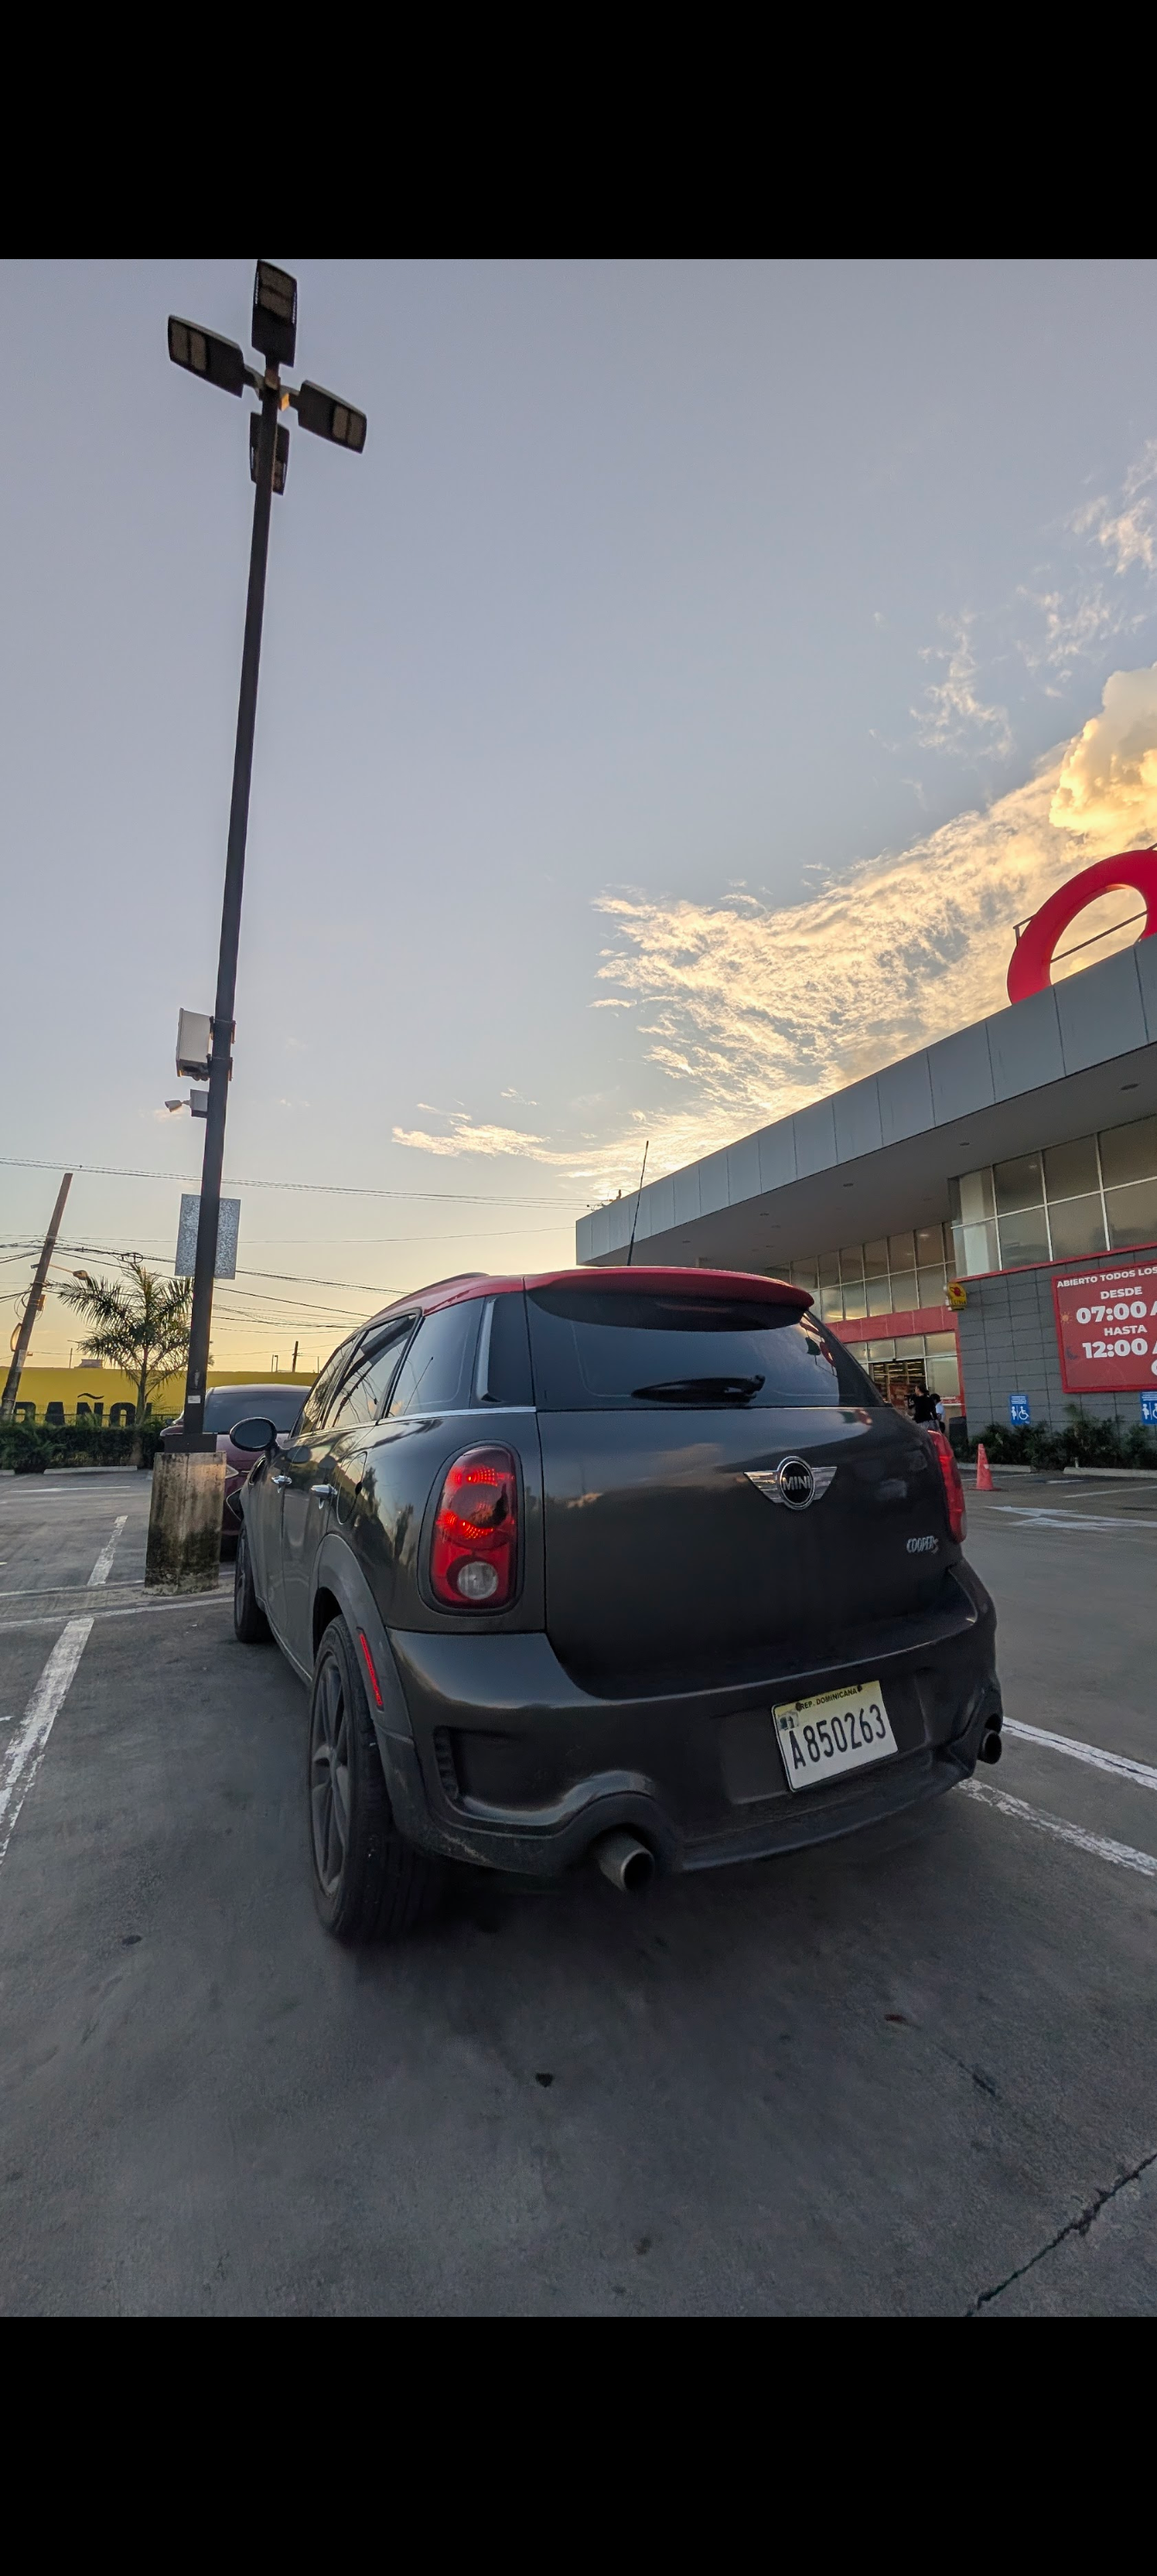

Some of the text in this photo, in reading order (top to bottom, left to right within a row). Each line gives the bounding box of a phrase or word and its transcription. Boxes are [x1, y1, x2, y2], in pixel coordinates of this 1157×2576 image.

[1057, 1276, 1098, 1288] ABIERTO
[1100, 1270, 1135, 1282] TODOS
[1100, 1286, 1142, 1299] DESDE
[1076, 1301, 1147, 1324] 07:00
[1104, 1324, 1148, 1336] HASTA
[1082, 1338, 1148, 1359] 12:00
[783, 1475, 811, 1490] MINI
[816, 1687, 857, 1705] DOMINICANA
[789, 1704, 886, 1769] A850263
